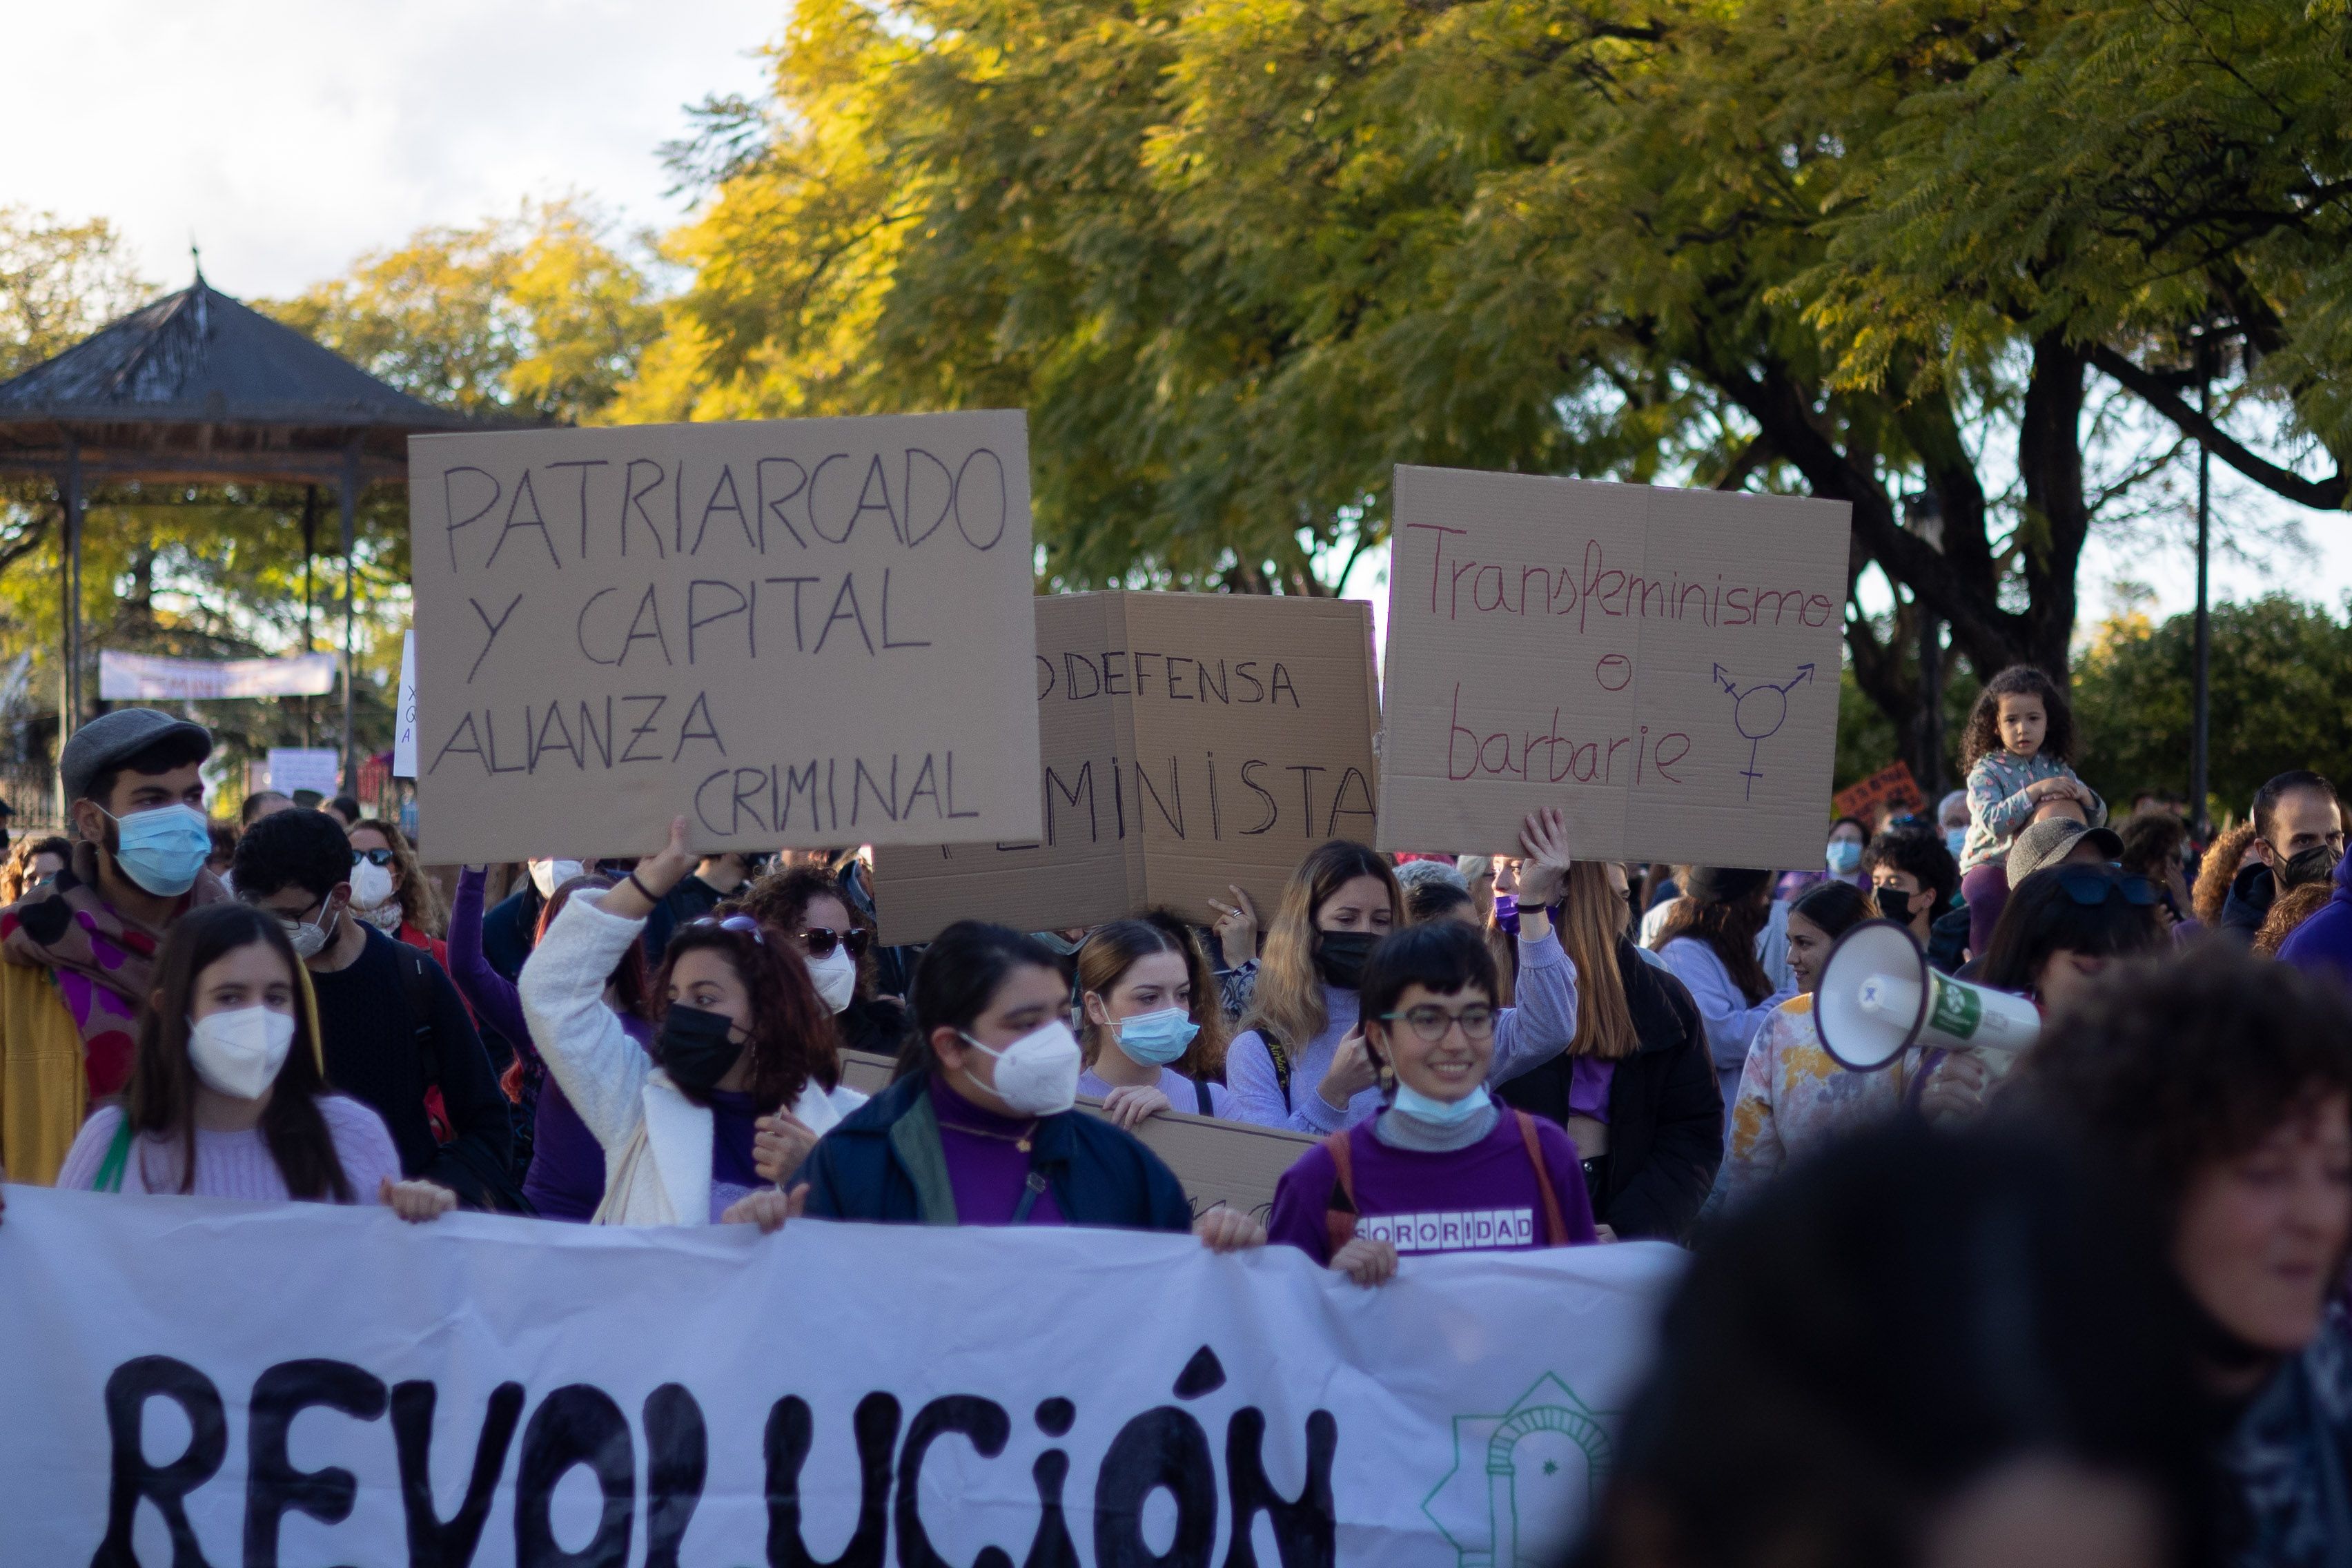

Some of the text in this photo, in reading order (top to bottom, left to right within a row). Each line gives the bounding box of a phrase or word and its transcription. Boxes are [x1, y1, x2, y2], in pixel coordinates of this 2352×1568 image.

[444, 448, 1006, 572] PATRIARCADO
[467, 567, 932, 684] Y CAPITAL
[1407, 522, 1833, 634] Transfeminismo
[428, 691, 727, 776] ALIANZA
[1449, 681, 1691, 785] barbarie
[694, 750, 979, 836] CRIMINAL
[1353, 1217, 1531, 1244] SORORIDAD
